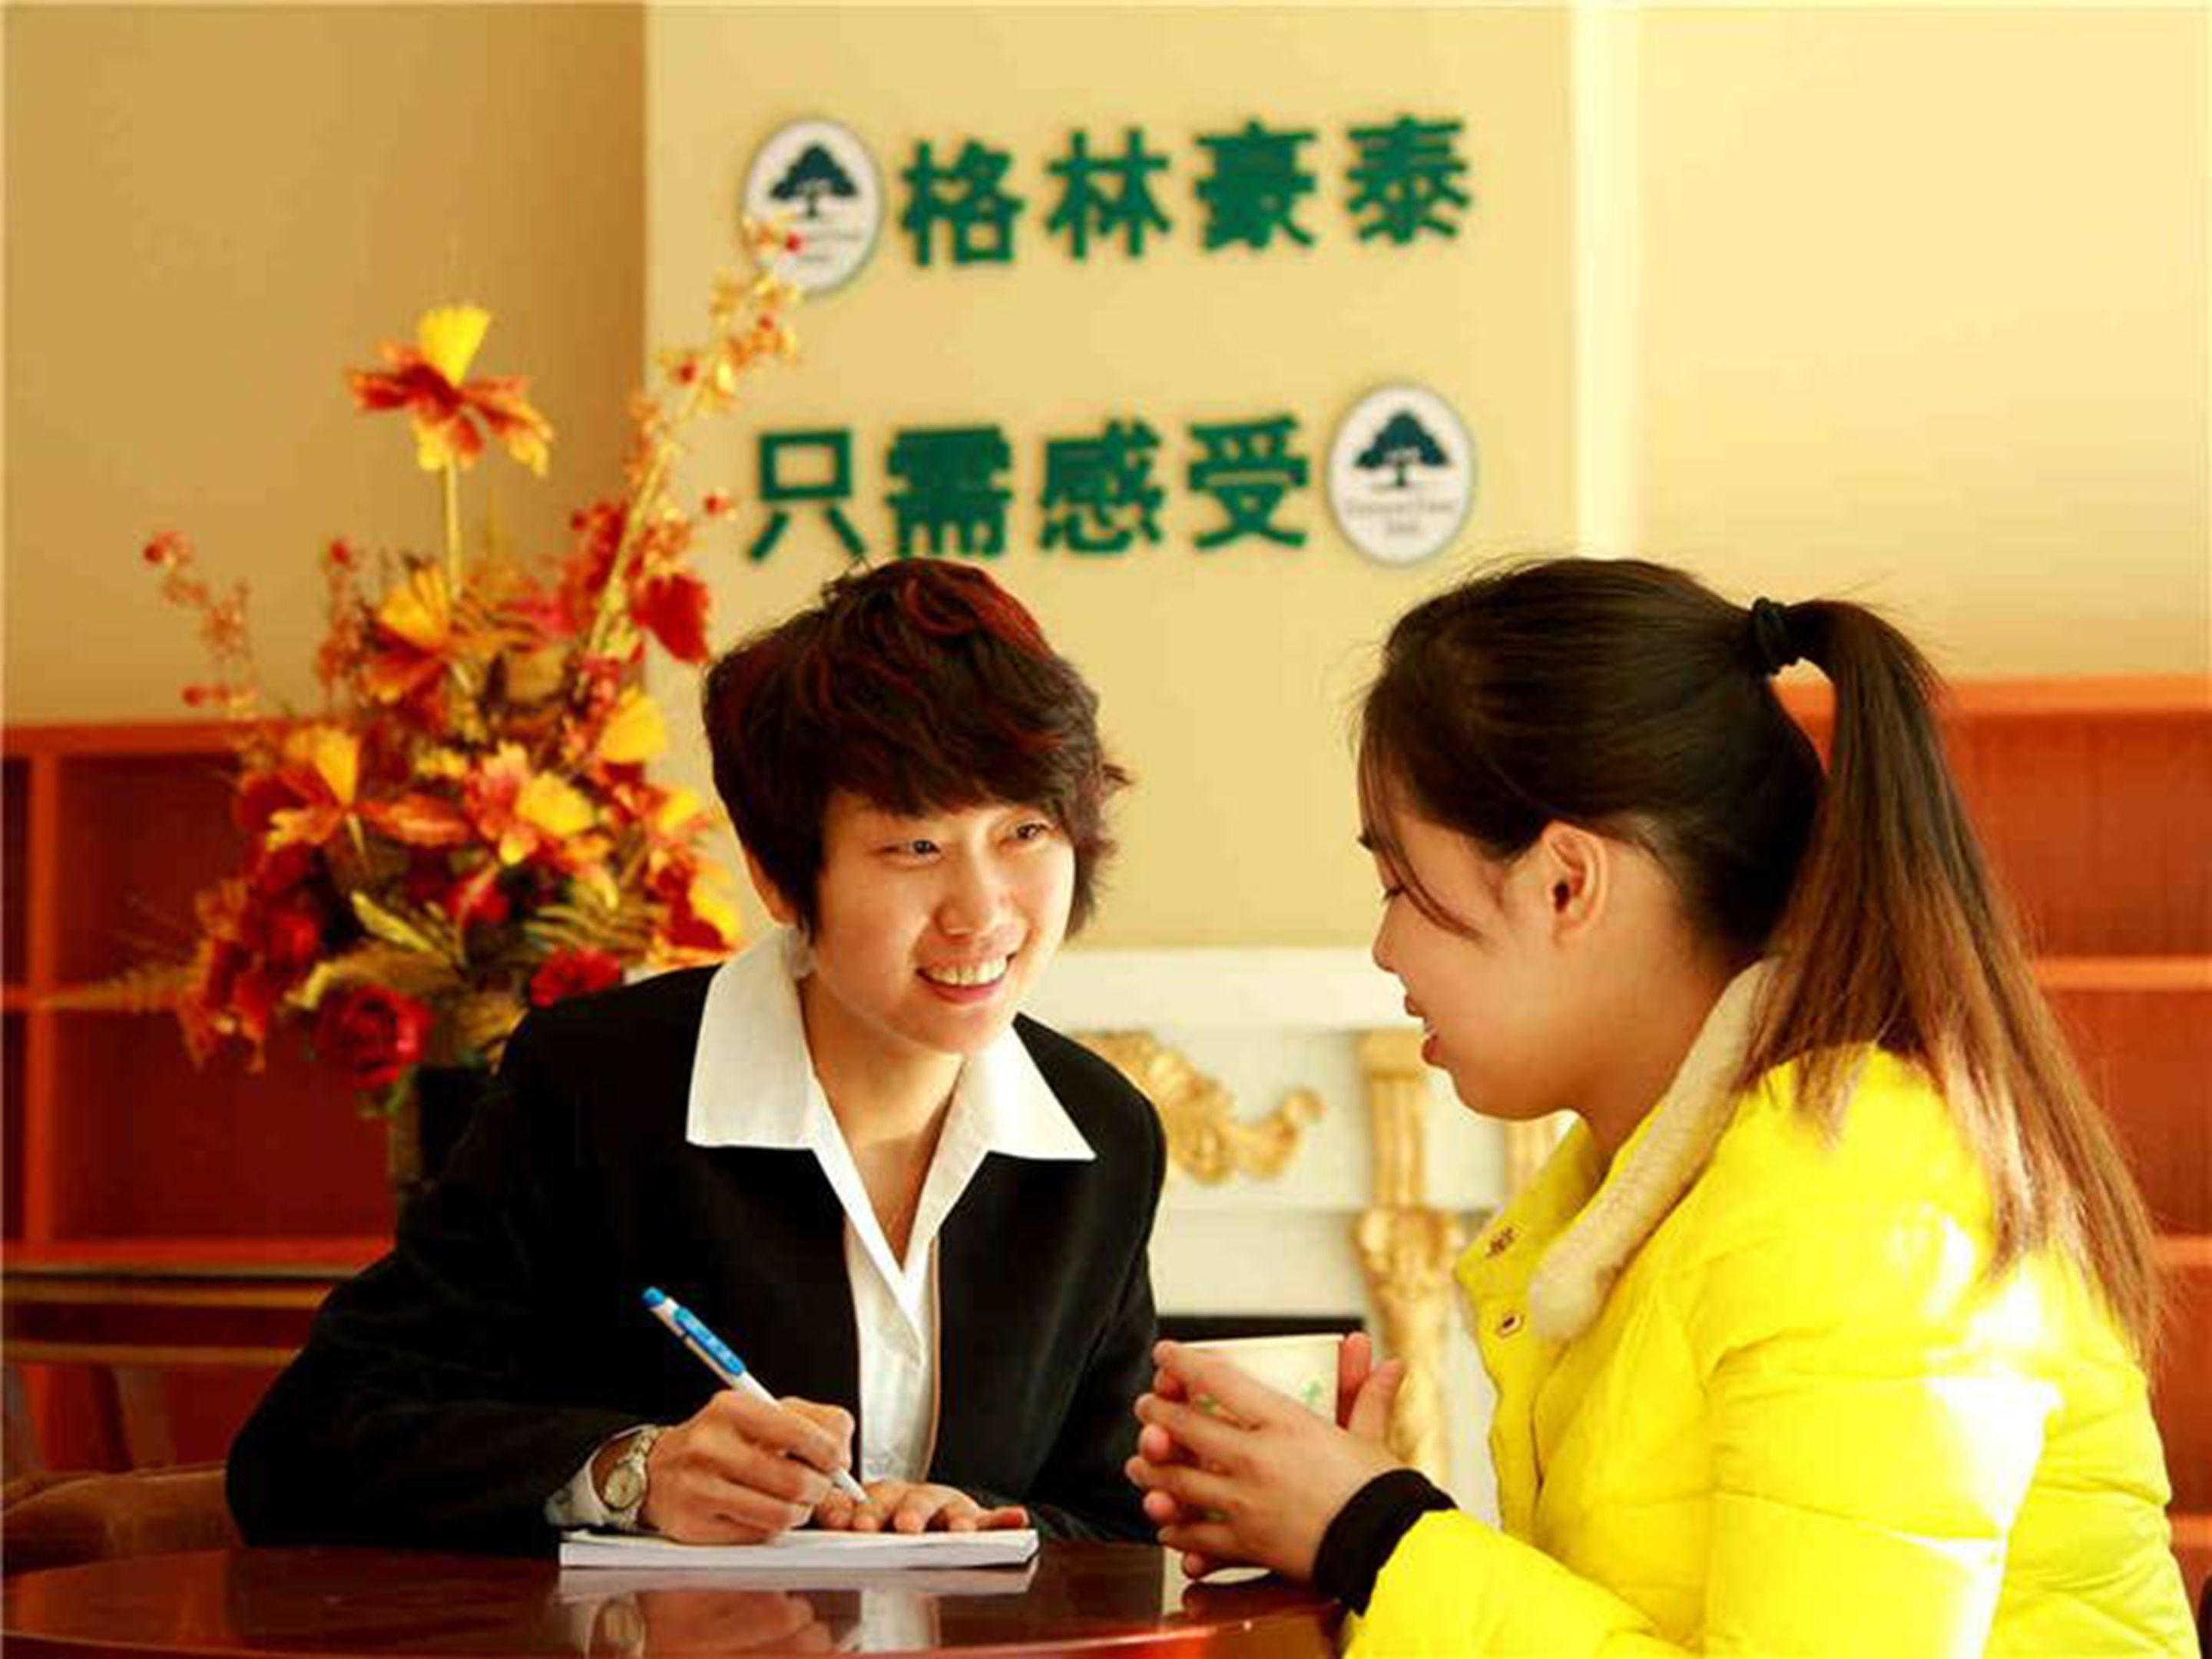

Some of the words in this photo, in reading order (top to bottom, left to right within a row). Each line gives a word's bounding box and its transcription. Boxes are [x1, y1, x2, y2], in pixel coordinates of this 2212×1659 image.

[900, 115, 1471, 267] 格林豪泰
[750, 414, 1311, 562] 只需感受
